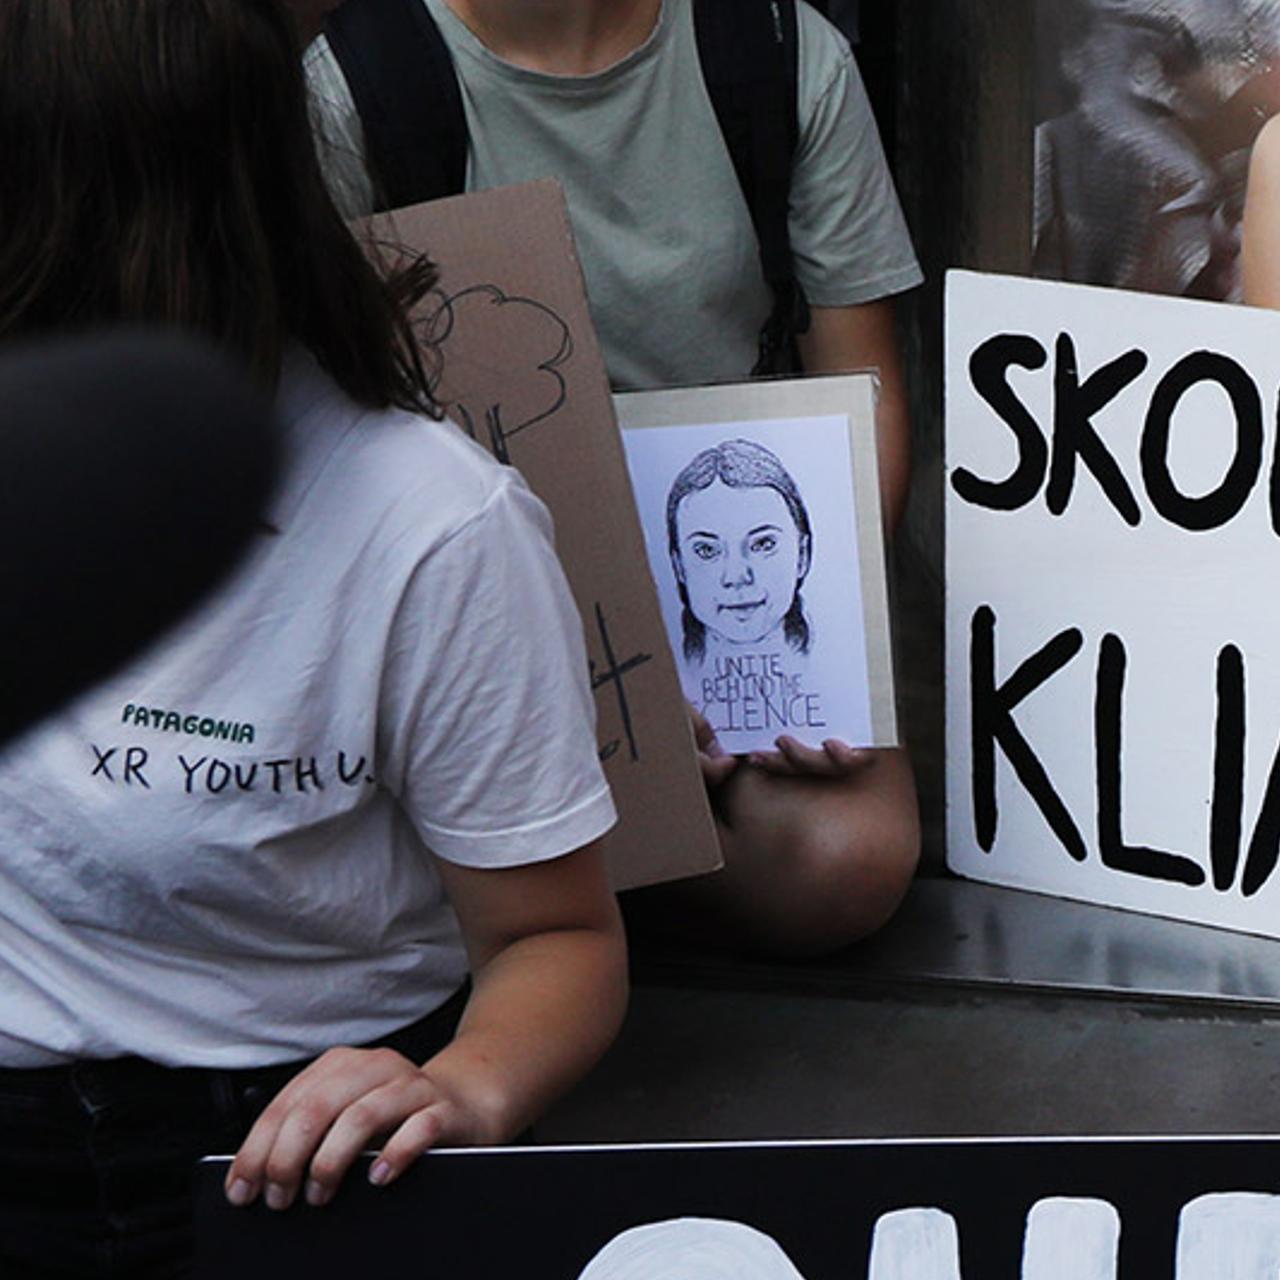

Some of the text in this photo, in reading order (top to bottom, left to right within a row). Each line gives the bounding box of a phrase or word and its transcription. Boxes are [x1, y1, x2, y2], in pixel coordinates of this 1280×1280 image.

[715, 653, 783, 680] UNITE
[702, 674, 775, 703] BEHIND
[121, 704, 254, 744] PATAGONIA
[91, 744, 150, 789] XR
[177, 754, 325, 794] YOUTH
